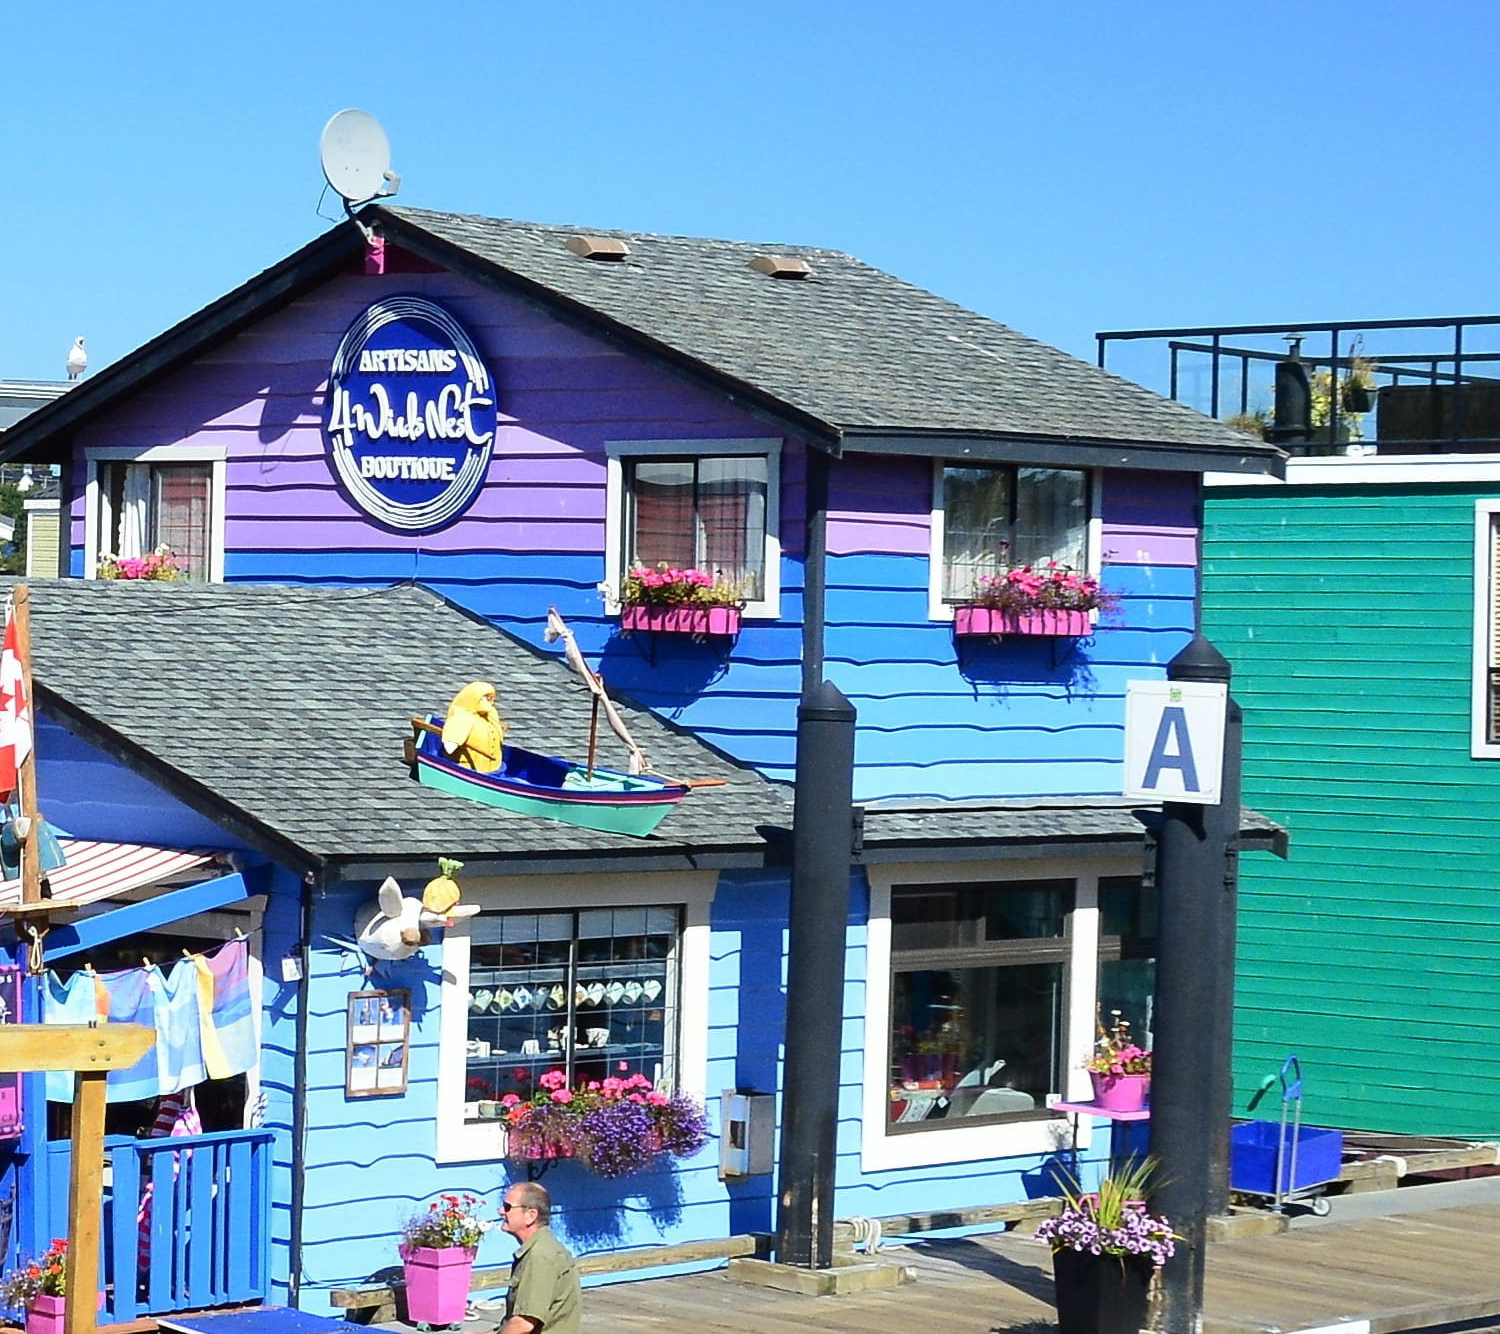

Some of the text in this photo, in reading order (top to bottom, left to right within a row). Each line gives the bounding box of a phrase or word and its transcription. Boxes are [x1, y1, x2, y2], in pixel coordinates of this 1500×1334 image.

[358, 349, 457, 373] ARTISANS
[361, 455, 456, 481] BOUTIQUE
[1141, 706, 1200, 793] A
